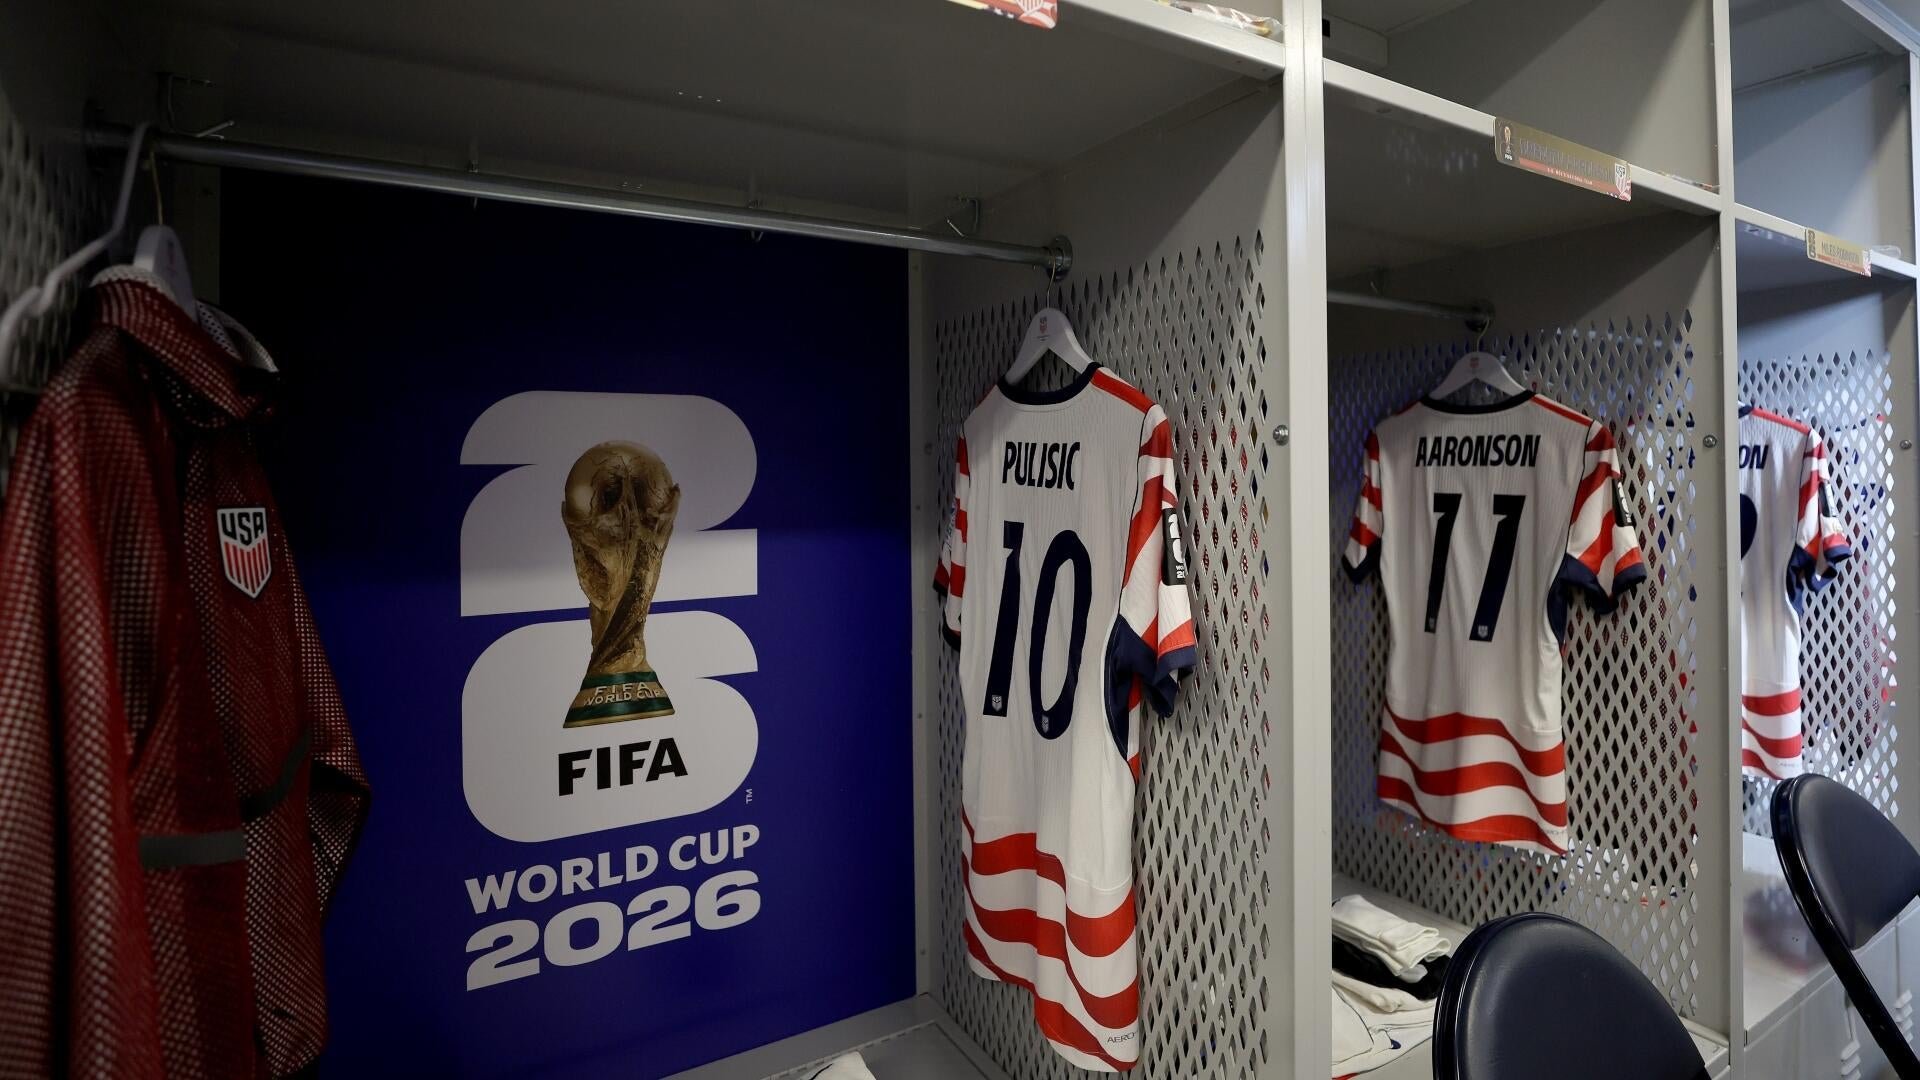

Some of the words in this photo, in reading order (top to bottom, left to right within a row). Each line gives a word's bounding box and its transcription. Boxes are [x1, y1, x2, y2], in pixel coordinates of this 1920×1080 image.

[1002, 440, 1081, 491] PULISIC
[1415, 433, 1541, 468] AARONSON
[220, 512, 265, 546] USA
[1424, 493, 1526, 642] 11
[983, 520, 1092, 740] 10
[584, 692, 631, 706] WORLD
[637, 688, 662, 699] CUP
[594, 682, 649, 695] FIFA
[558, 737, 688, 796] FIFA
[465, 845, 658, 914] WORLD
[668, 824, 760, 870] CUP
[466, 870, 761, 991] 2026
